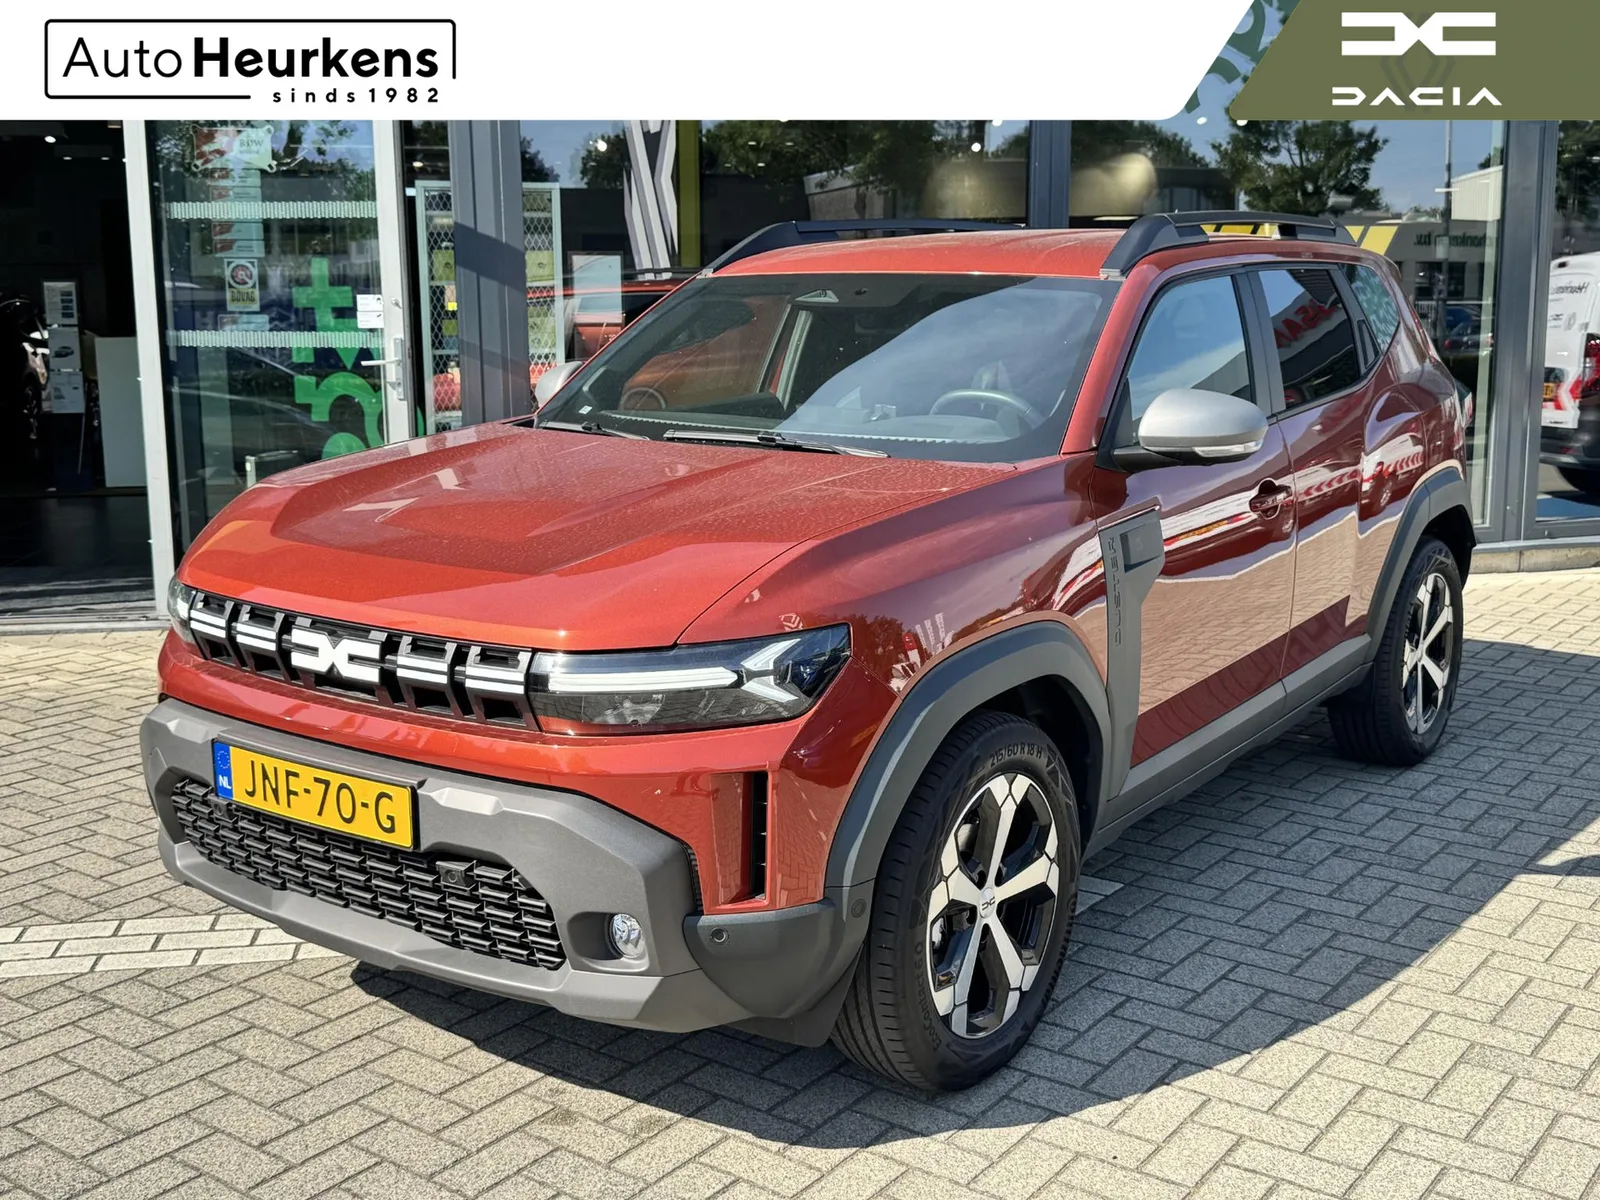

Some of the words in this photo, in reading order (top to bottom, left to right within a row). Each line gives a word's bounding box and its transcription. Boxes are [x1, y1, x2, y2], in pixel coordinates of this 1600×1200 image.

[230, 290, 256, 303] BOVAG
[1107, 536, 1122, 647] DUSTER
[989, 743, 1019, 768] 215/60
[1019, 742, 1026, 755] R
[1026, 742, 1035, 756] 18
[218, 774, 232, 790] NL
[244, 759, 397, 835] JNF-70-G
